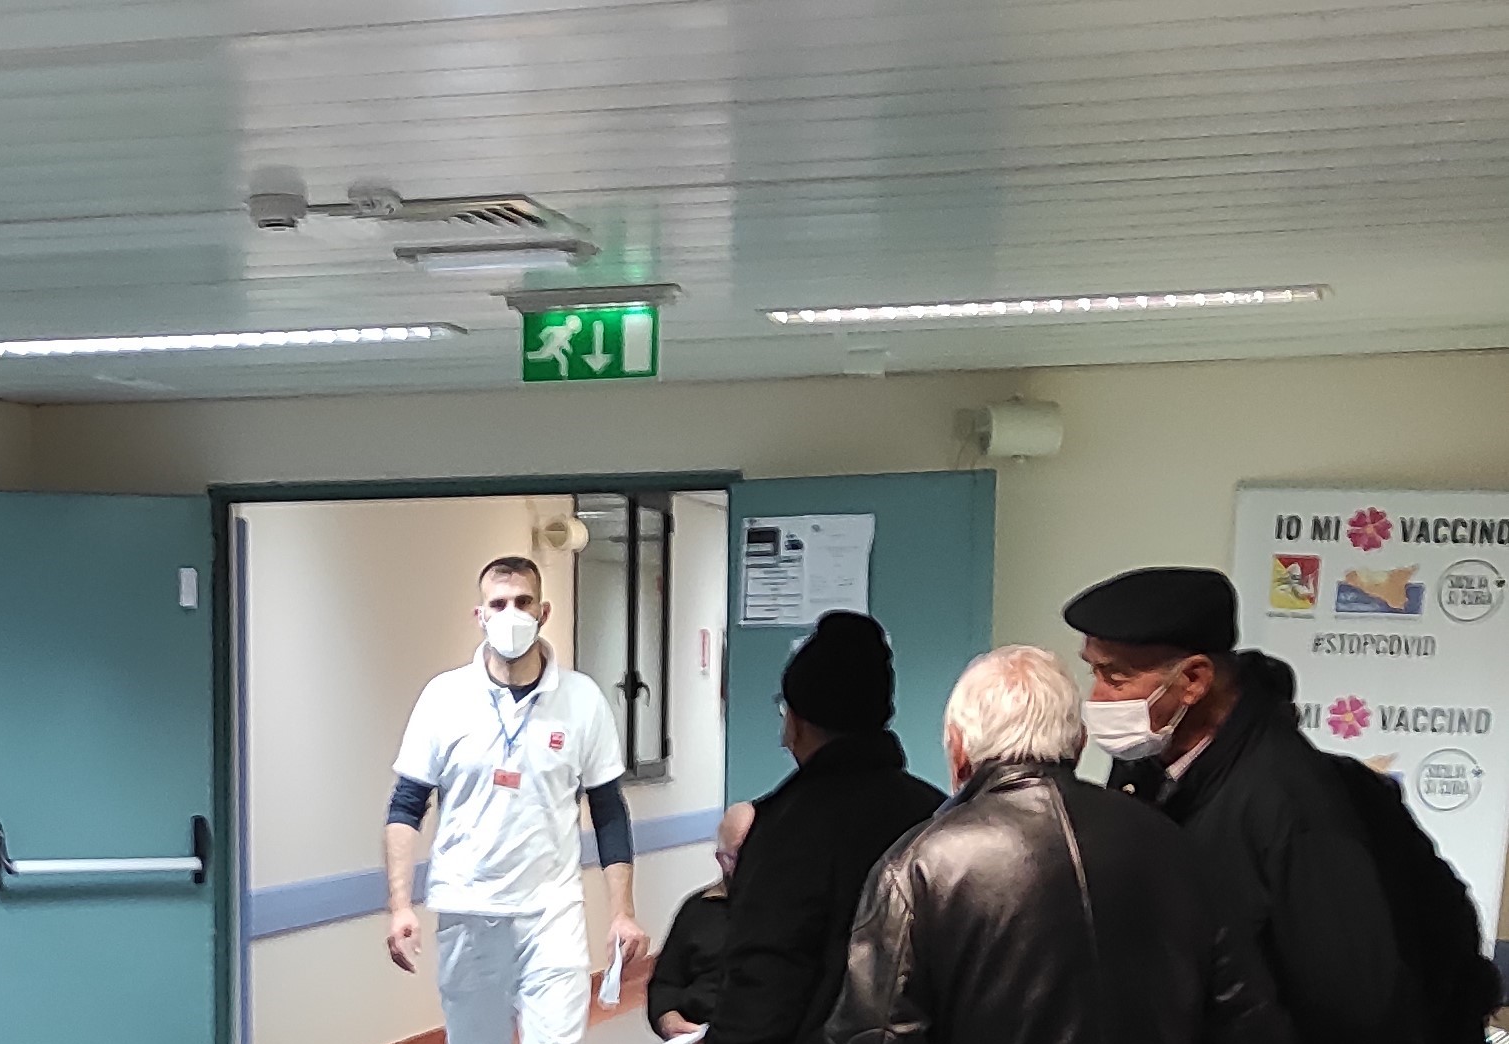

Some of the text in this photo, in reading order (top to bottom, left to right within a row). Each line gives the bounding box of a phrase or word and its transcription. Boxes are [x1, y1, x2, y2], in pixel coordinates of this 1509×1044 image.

[1275, 514, 1509, 544] IO MI VACCINO
[1378, 705, 1491, 734] VACCINO
